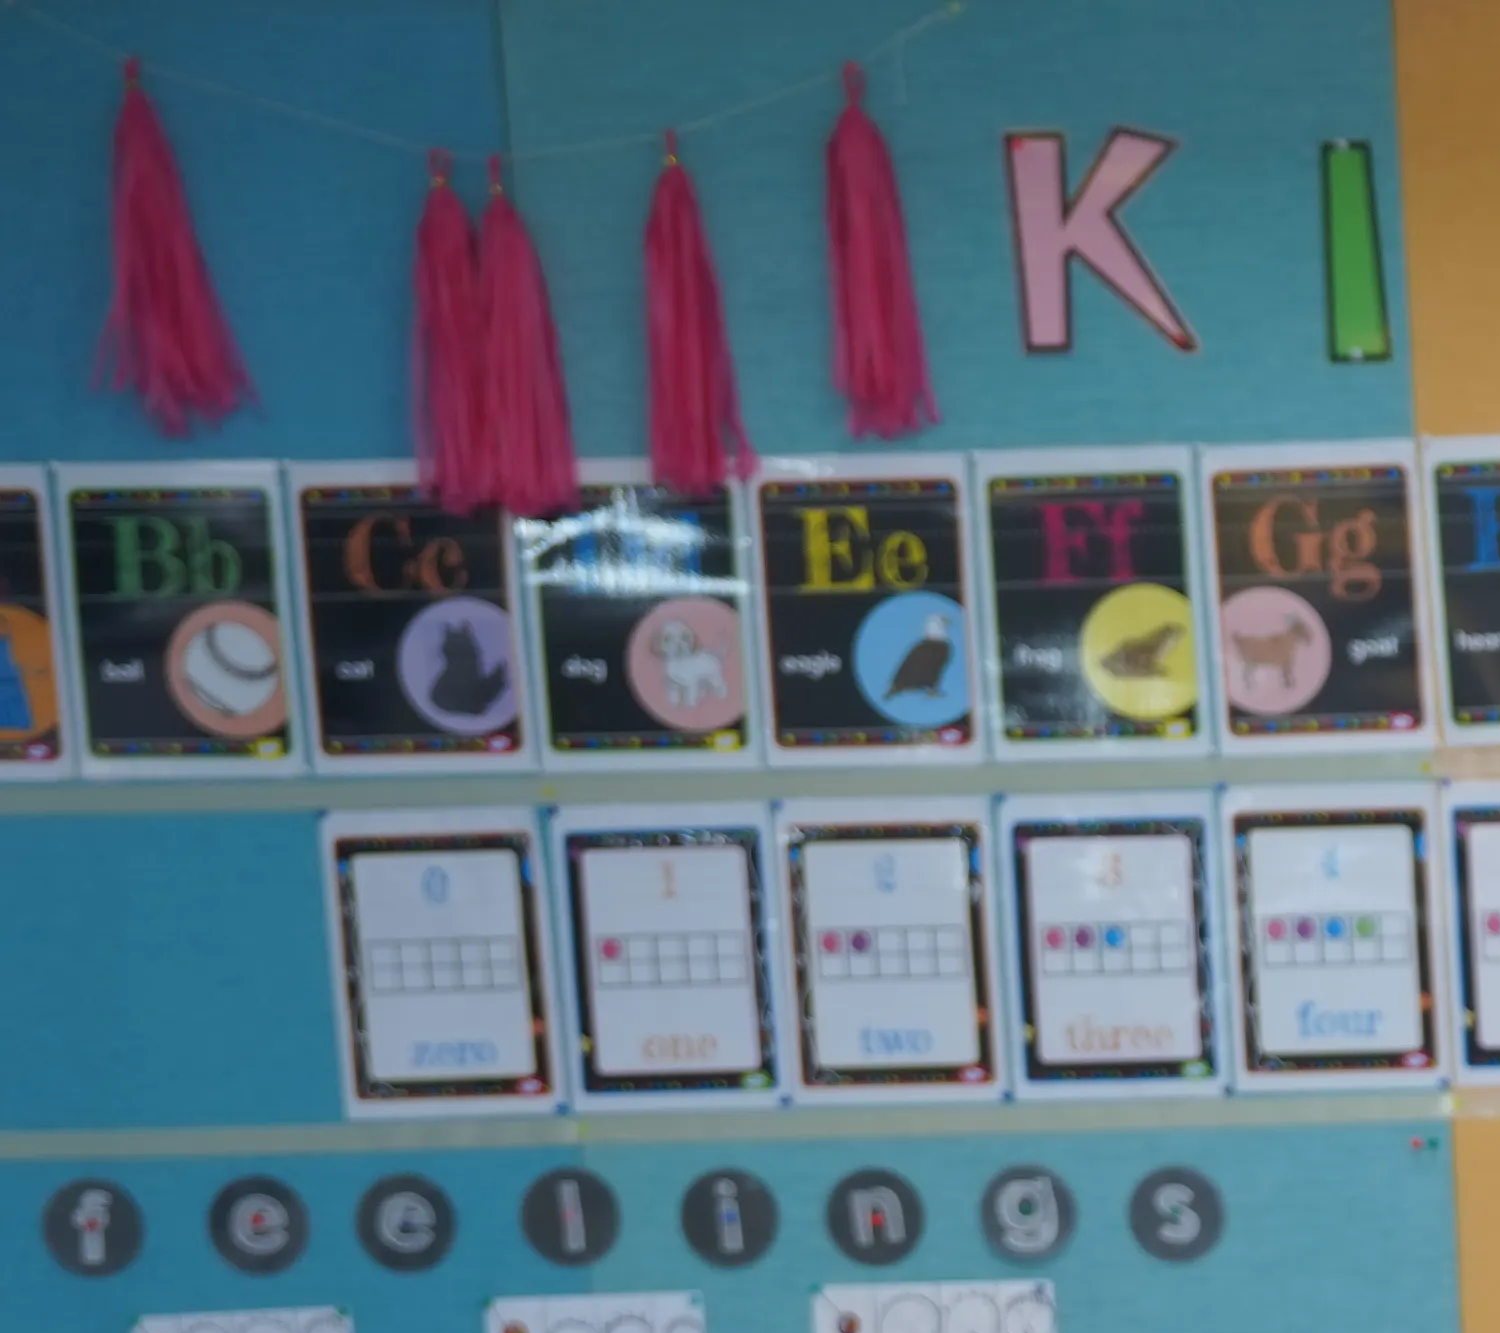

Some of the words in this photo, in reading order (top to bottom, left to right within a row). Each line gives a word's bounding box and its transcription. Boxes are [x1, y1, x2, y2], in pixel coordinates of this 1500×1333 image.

[111, 515, 242, 598] Bb
[345, 515, 468, 596] Cc
[802, 507, 928, 592] Ee
[1039, 502, 1145, 585] Ff
[1250, 496, 1381, 601] Gg
[643, 1031, 719, 1061] one
[860, 1024, 932, 1055] two
[1064, 1017, 1172, 1052] three
[1296, 1001, 1384, 1040] four
[74, 1177, 1200, 1264] feelings
